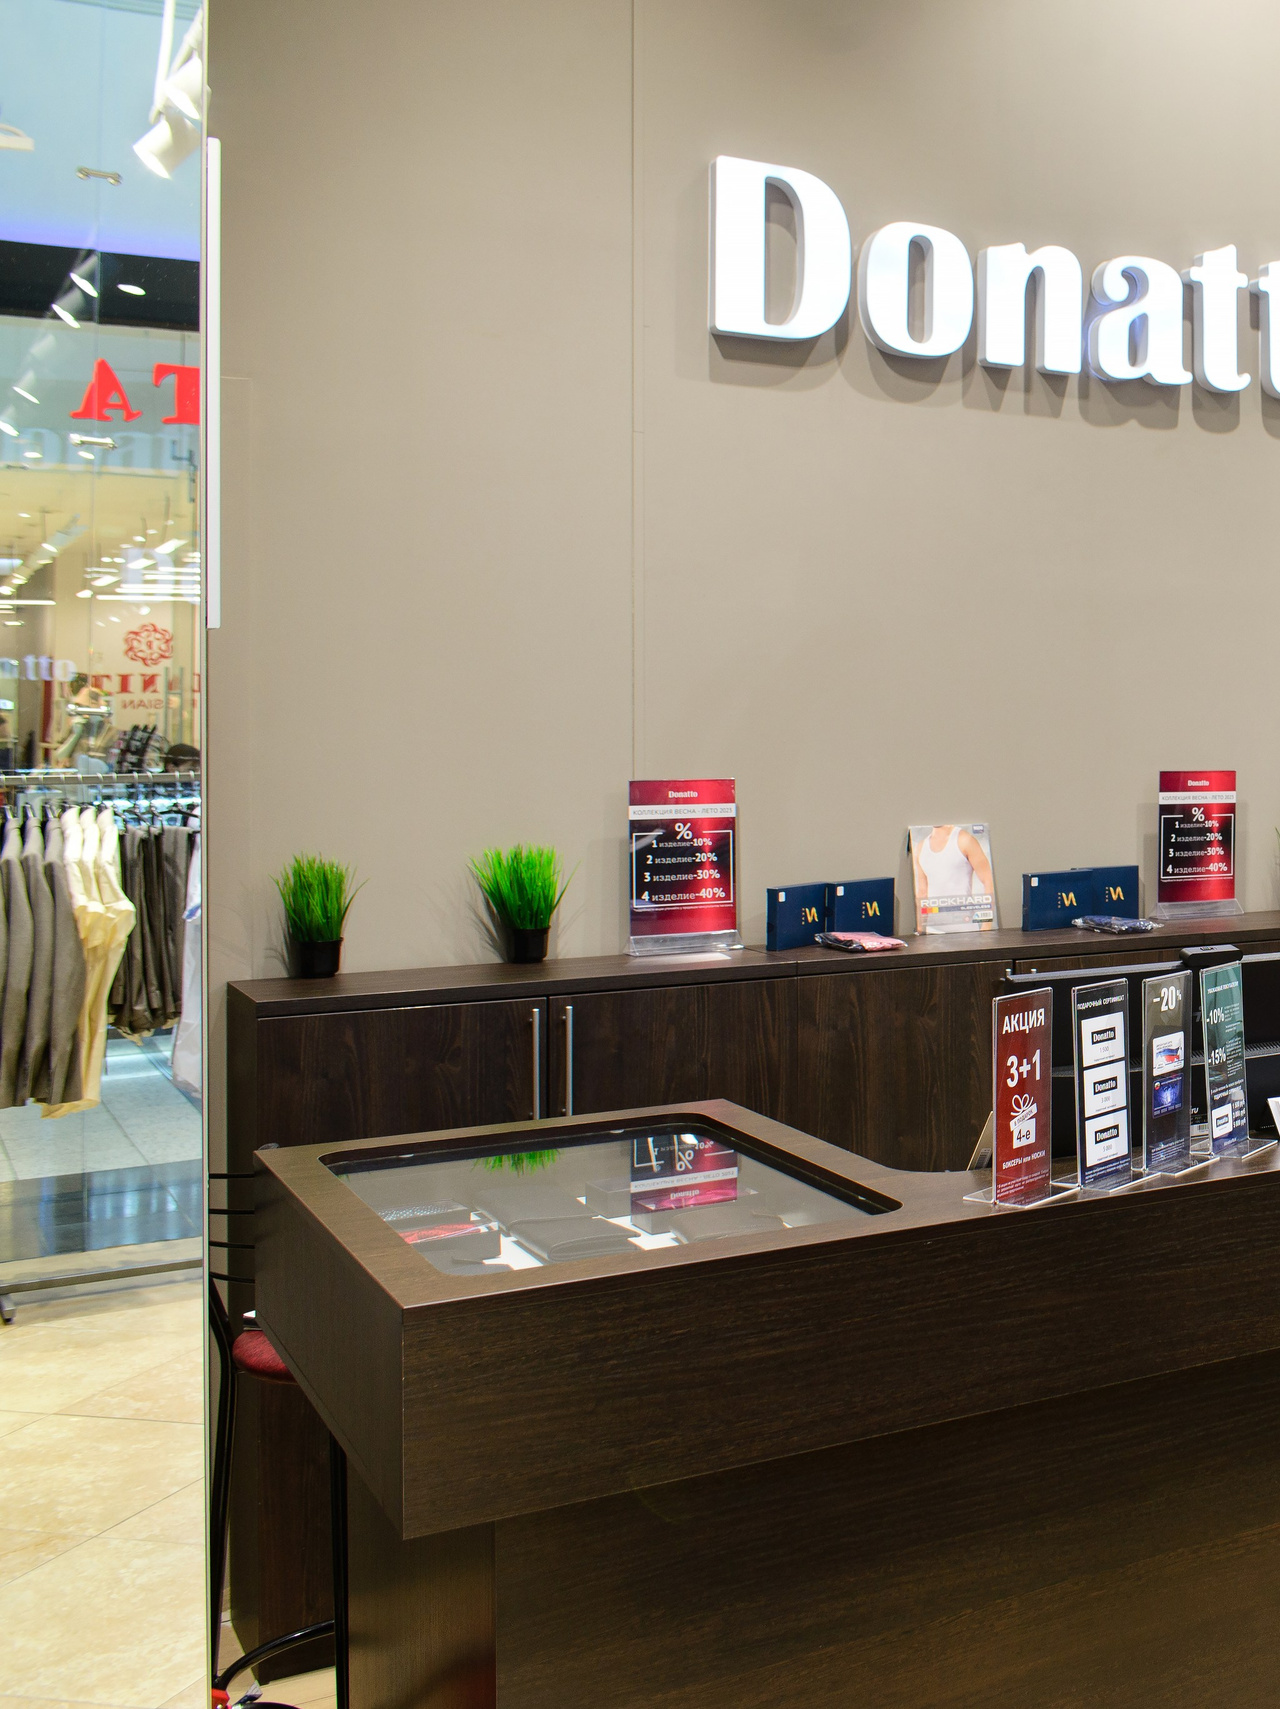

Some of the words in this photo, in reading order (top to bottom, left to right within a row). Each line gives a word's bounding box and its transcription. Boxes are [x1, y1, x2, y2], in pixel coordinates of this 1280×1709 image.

[668, 790, 698, 799] Donatto
[1191, 807, 1205, 822] %
[674, 822, 693, 840] %
[1175, 821, 1180, 829] 1
[652, 839, 658, 848] 1
[1171, 834, 1176, 842] 2
[1168, 848, 1174, 857] 3
[646, 855, 653, 865] 2
[1166, 864, 1173, 874] 4
[643, 872, 651, 882] 3
[641, 891, 650, 902] 4
[920, 895, 992, 907] ROCKHARD
[1002, 1007, 1045, 1035] АКЦИЯ
[1206, 1007, 1225, 1025] -10%
[1093, 1029, 1115, 1043] Donatto
[1208, 1046, 1227, 1066] -15%
[1006, 1048, 1041, 1088] 3+1
[1094, 1079, 1116, 1093] Donatto
[1096, 1127, 1118, 1142] Donatto
